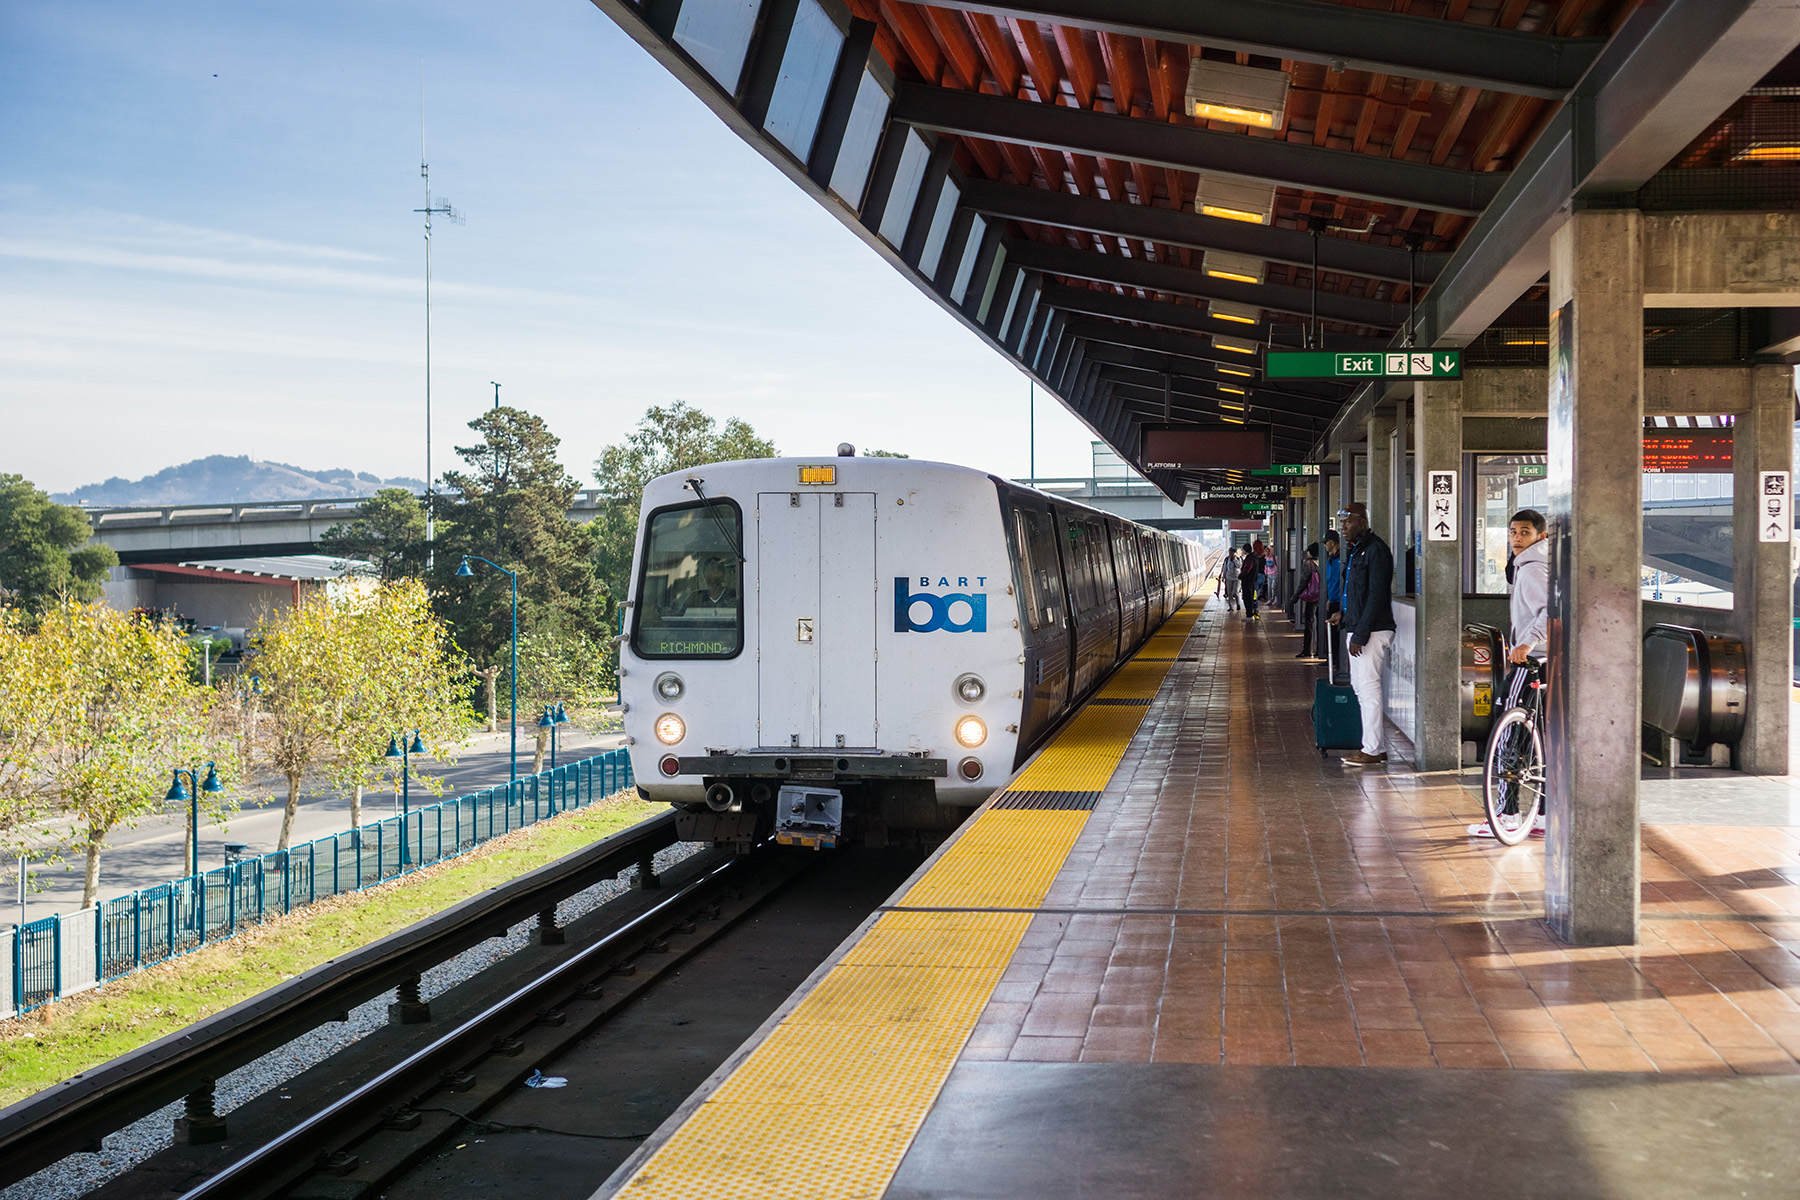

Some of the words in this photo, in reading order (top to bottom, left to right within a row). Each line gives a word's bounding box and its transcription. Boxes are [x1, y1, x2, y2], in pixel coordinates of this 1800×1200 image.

[1343, 357, 1374, 371] Exit
[1283, 466, 1298, 474] Exit
[920, 576, 987, 587] BART
[660, 642, 722, 653] RICHMOND
